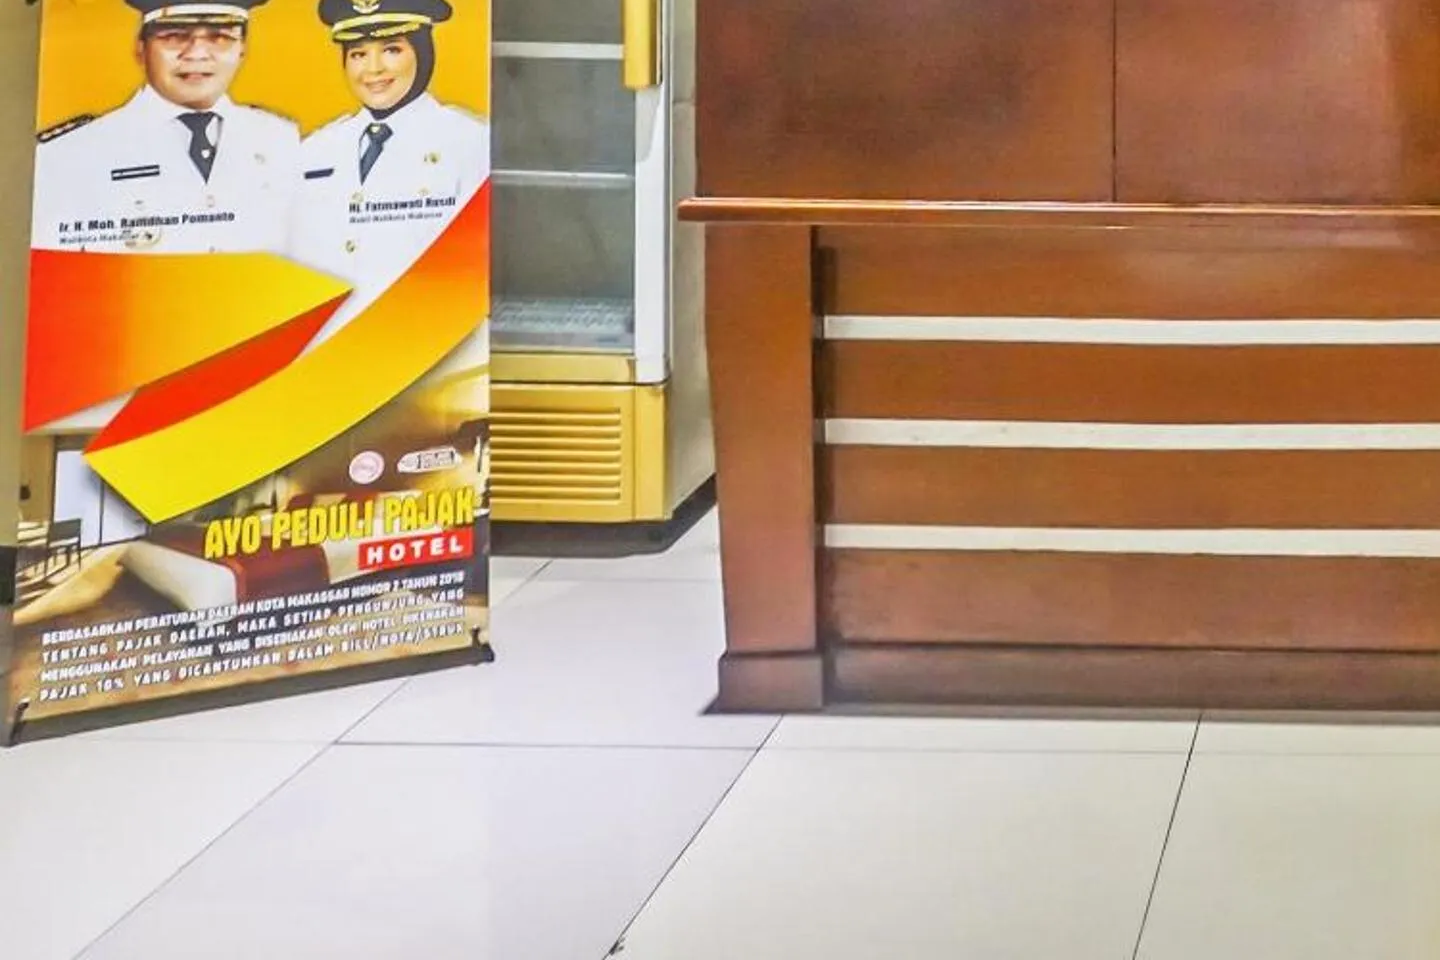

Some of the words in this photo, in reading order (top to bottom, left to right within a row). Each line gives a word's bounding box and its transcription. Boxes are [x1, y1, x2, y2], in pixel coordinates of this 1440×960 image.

[120, 215, 179, 229] Ramdhan
[181, 211, 236, 224] Pomanto
[203, 515, 261, 560] AYO
[272, 499, 374, 551] PEDULI
[384, 487, 475, 533] PAJAK
[366, 536, 465, 565] HOTEL
[42, 643, 109, 664] TENTANG
[116, 635, 163, 652] PAJAK
[238, 615, 277, 634] MAKA
[283, 607, 332, 627] SETIAP
[338, 594, 424, 619] PENGUNJUNG
[431, 588, 465, 608] YANG
[135, 608, 206, 631] PERATURAN
[207, 599, 254, 620] DAERAH
[256, 595, 285, 614] KOTA
[287, 587, 350, 608] MAKASSAR
[351, 581, 392, 599] NOMOR
[401, 574, 437, 591] TAHUN
[40, 682, 88, 702] PAJAK
[96, 676, 125, 693] 10%
[134, 670, 171, 687] YANG
[179, 650, 281, 681] DICANTUMKAN
[288, 643, 335, 661] DALAM
[41, 656, 138, 683] MENGGUNAKAN
[142, 644, 214, 666] PELAYANAN
[218, 638, 251, 655] YANG
[254, 627, 323, 650] DISEDIAKAN
[327, 620, 358, 637] OLEH
[362, 616, 396, 632] HOTEL
[403, 605, 465, 626] DIKENAKAN
